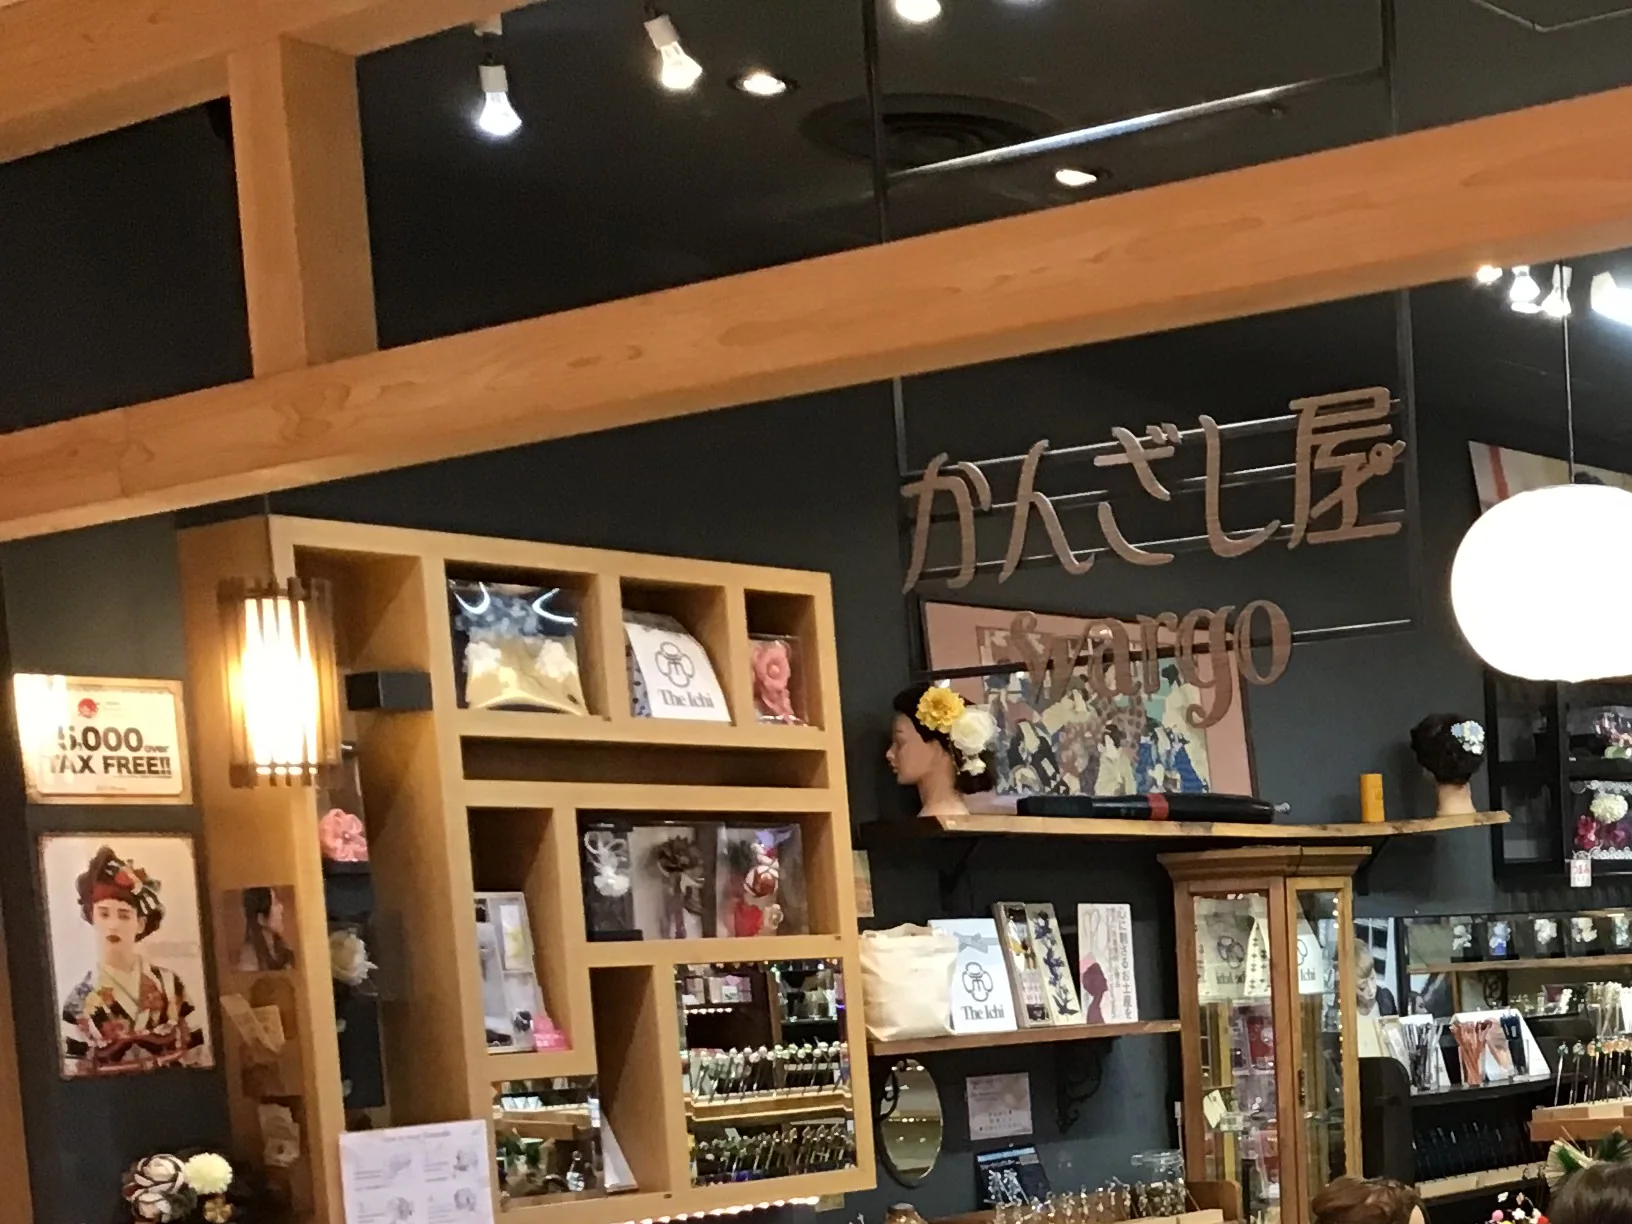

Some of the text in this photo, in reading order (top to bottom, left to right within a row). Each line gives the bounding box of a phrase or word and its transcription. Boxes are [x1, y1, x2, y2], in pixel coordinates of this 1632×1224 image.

[900, 386, 1406, 594] かんざし屋
[1008, 599, 1292, 729] wargo
[103, 756, 171, 775] FREE!!
[960, 1005, 983, 1020] The
